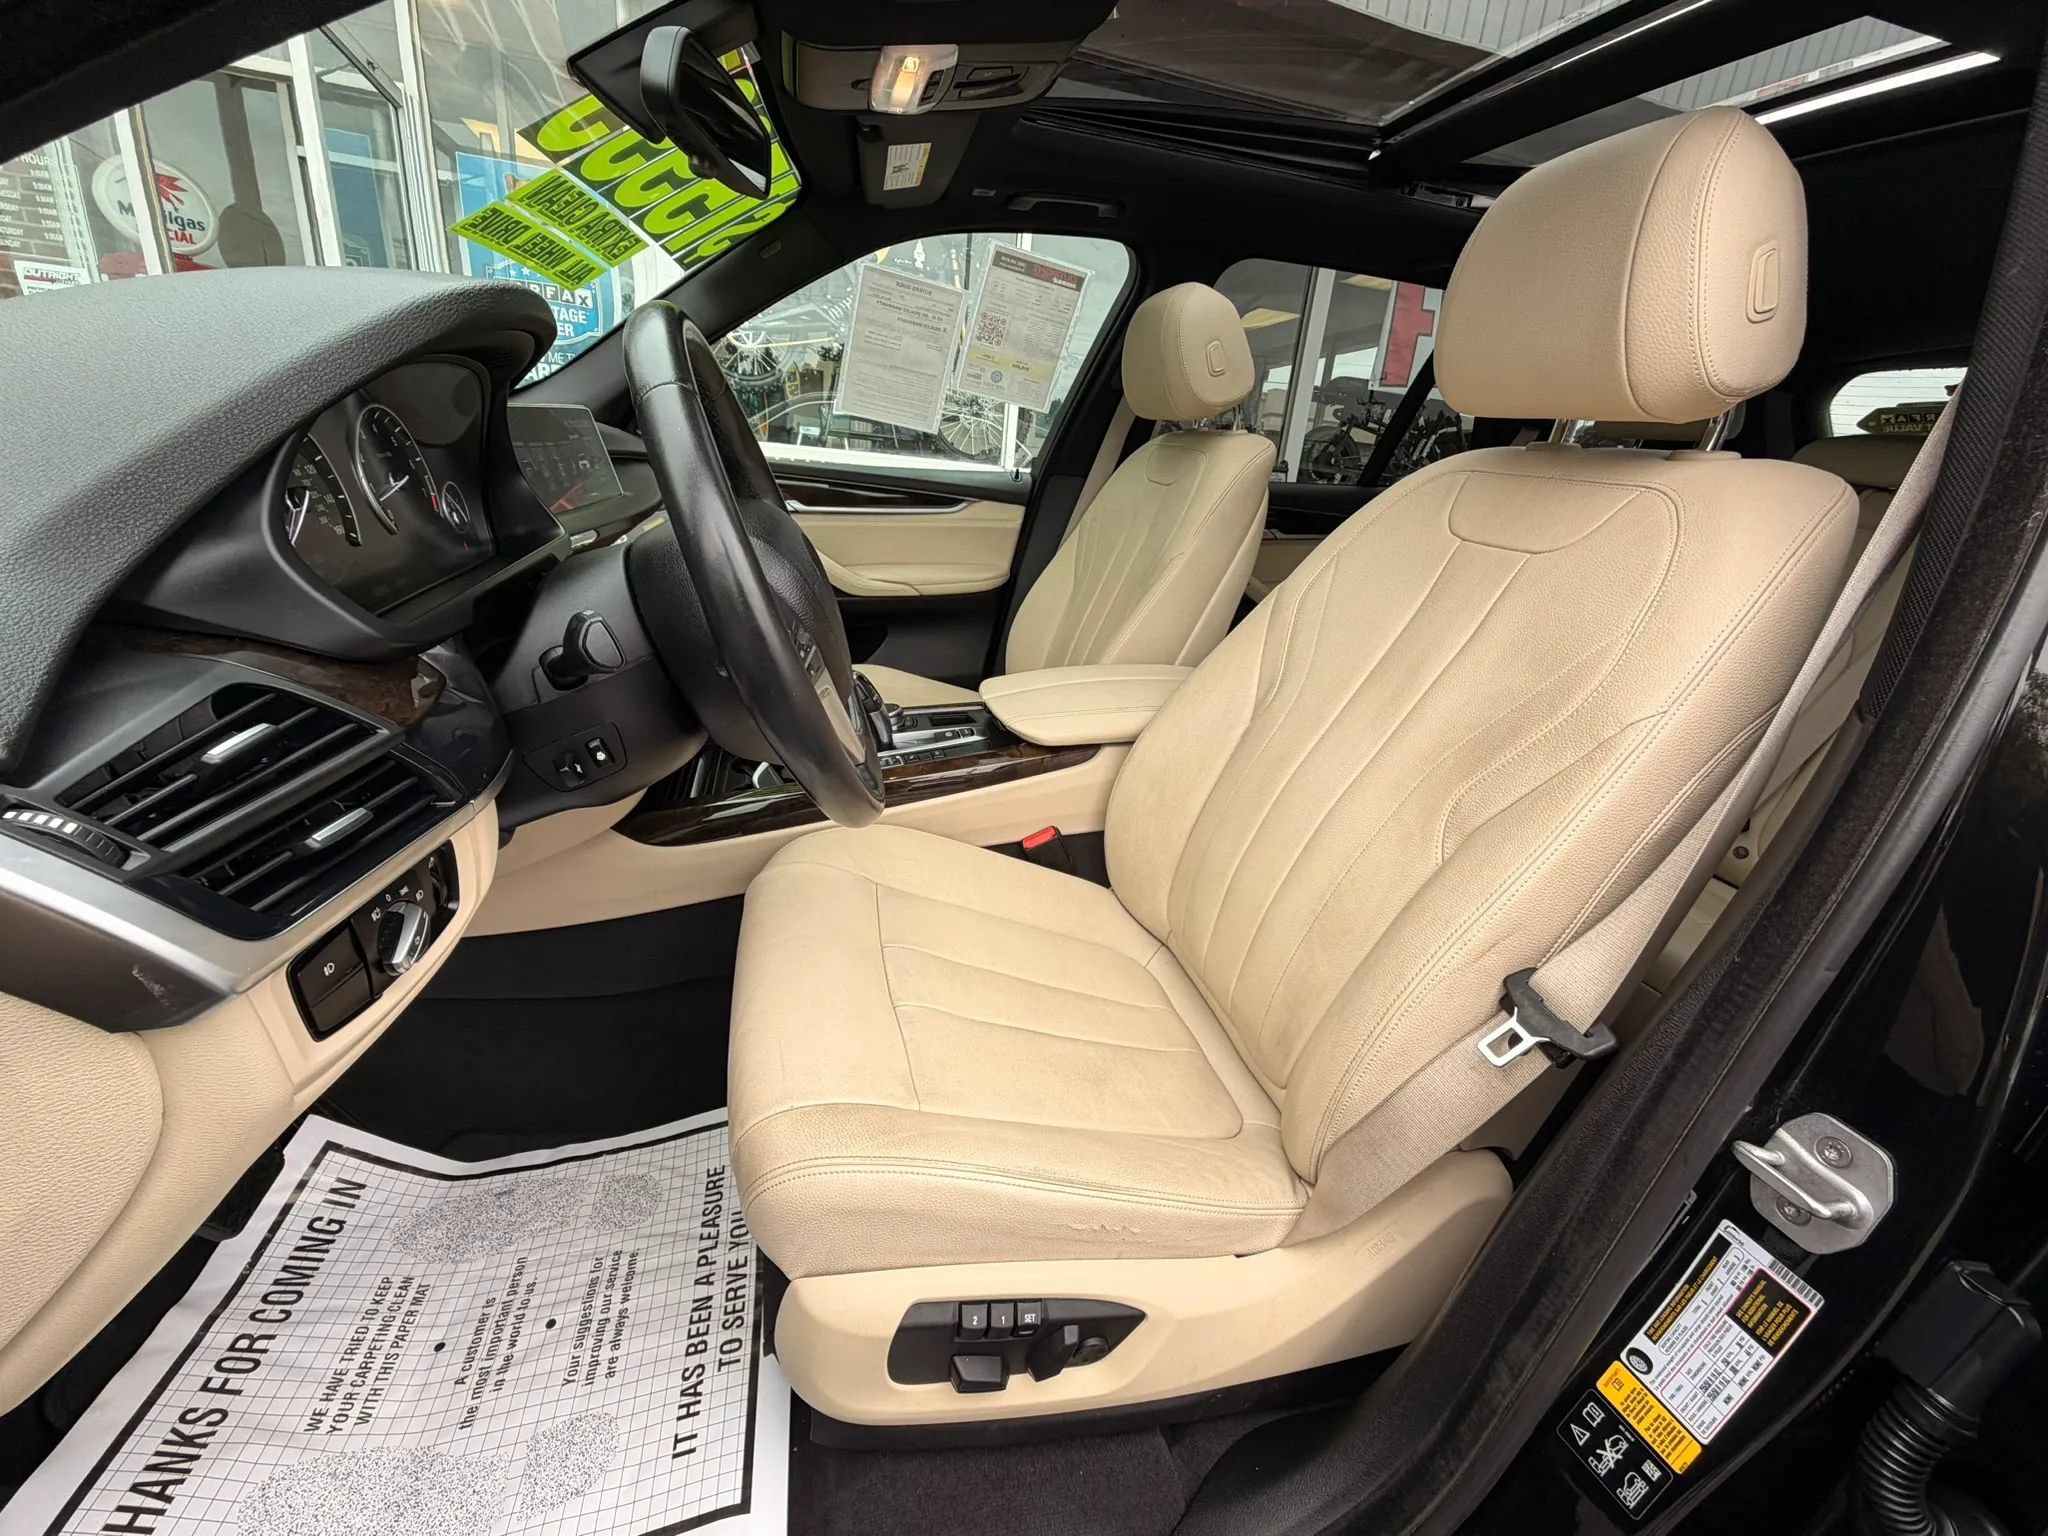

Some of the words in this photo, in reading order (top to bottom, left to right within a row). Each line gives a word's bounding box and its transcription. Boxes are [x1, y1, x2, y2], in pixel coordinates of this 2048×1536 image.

[20, 152, 50, 166] HOUR
[116, 199, 206, 232] Milgas
[519, 282, 593, 309] RFAX
[697, 1165, 725, 1268] PLEASURE
[506, 1256, 527, 1298] person
[604, 1250, 623, 1291] service
[620, 1247, 641, 1306] welcome.
[694, 1271, 716, 1287] A
[482, 1296, 497, 1309] is
[517, 1298, 531, 1312] to
[600, 1293, 613, 1315] our
[721, 1255, 748, 1331] SERVE
[480, 1299, 513, 1363] important
[506, 1312, 526, 1351] world
[561, 1355, 582, 1388] Your
[573, 1275, 600, 1350] suggestions
[590, 1256, 604, 1274] for
[608, 1307, 630, 1352] always
[685, 1295, 714, 1358] BEEN
[972, 1315, 978, 1325] 2
[1001, 1315, 1005, 1325] 1
[1024, 1313, 1037, 1323] SET
[102, 1407, 229, 1535] HANKS
[198, 1333, 278, 1396] FOR
[249, 1216, 347, 1324] COMING
[322, 1177, 367, 1209] IN
[303, 1407, 329, 1433] WE
[319, 1368, 349, 1402] HAVE
[339, 1326, 370, 1364] TRIED
[360, 1308, 380, 1322] TO
[370, 1276, 394, 1306] KEEP
[326, 1392, 360, 1434] YOUR
[350, 1315, 397, 1388] CARPETING
[387, 1276, 415, 1313] CLEAN
[353, 1387, 385, 1427] WITH
[373, 1353, 400, 1384] THIS
[390, 1308, 420, 1350] PAPER
[411, 1283, 431, 1308] MAT
[461, 1312, 491, 1373] customer
[581, 1317, 611, 1388] improving
[718, 1337, 743, 1372] TO
[454, 1375, 469, 1386] A
[471, 1364, 492, 1401] most
[489, 1377, 505, 1394] in
[495, 1354, 514, 1378] the
[604, 1356, 619, 1380] are
[676, 1363, 706, 1422] HAS
[458, 1405, 479, 1431] the
[671, 1432, 698, 1460] IT
